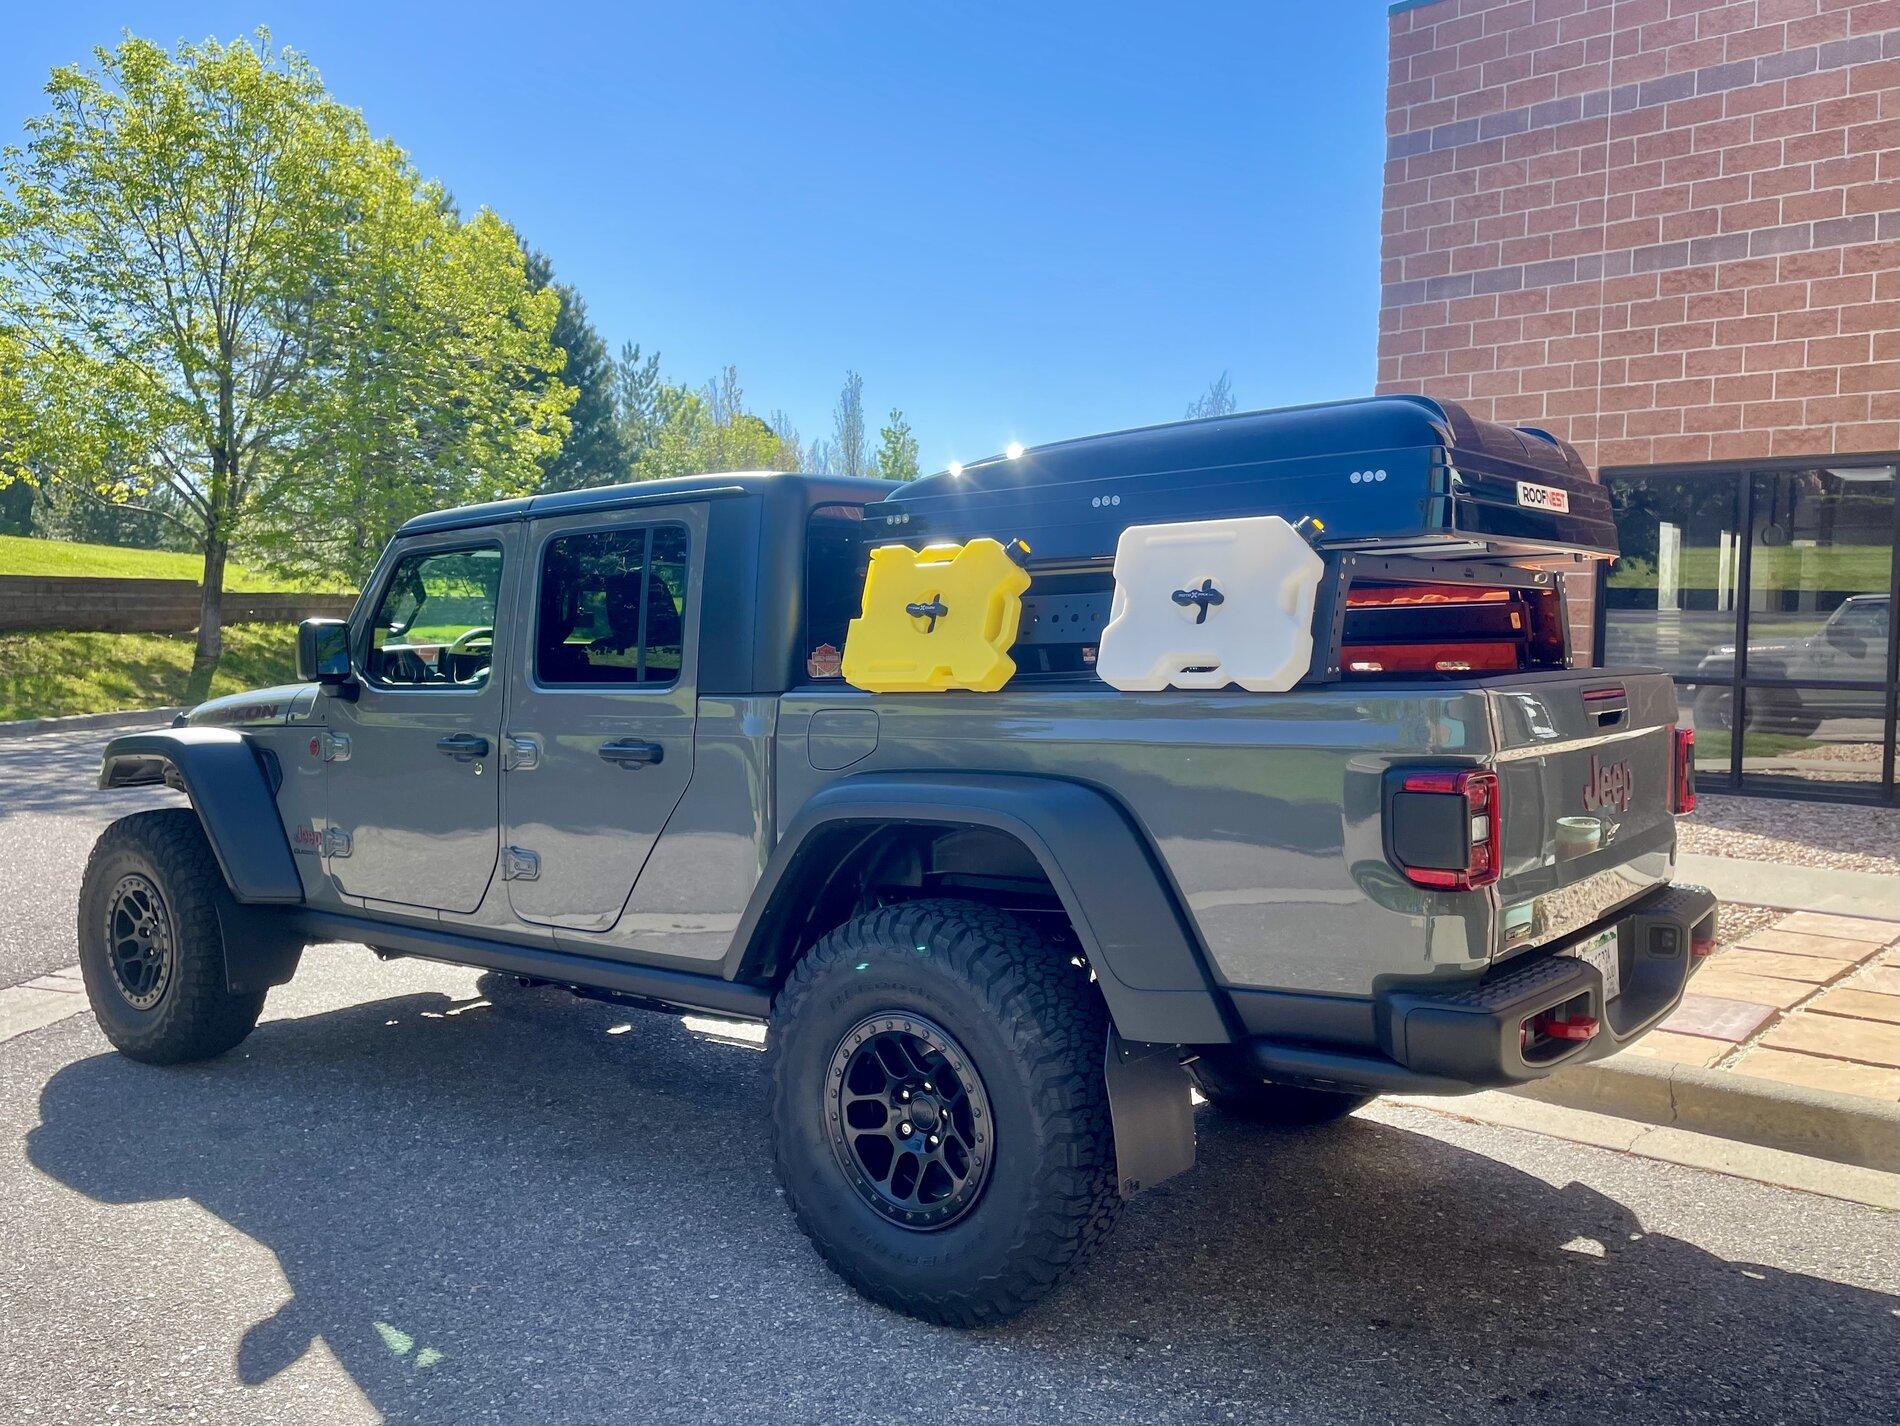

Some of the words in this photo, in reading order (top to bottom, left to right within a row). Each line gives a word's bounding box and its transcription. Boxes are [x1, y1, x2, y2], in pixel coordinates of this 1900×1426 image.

[1522, 486, 1565, 508] ROOFNEST
[1583, 754, 1632, 812] Jeep
[294, 825, 322, 848] Jeep
